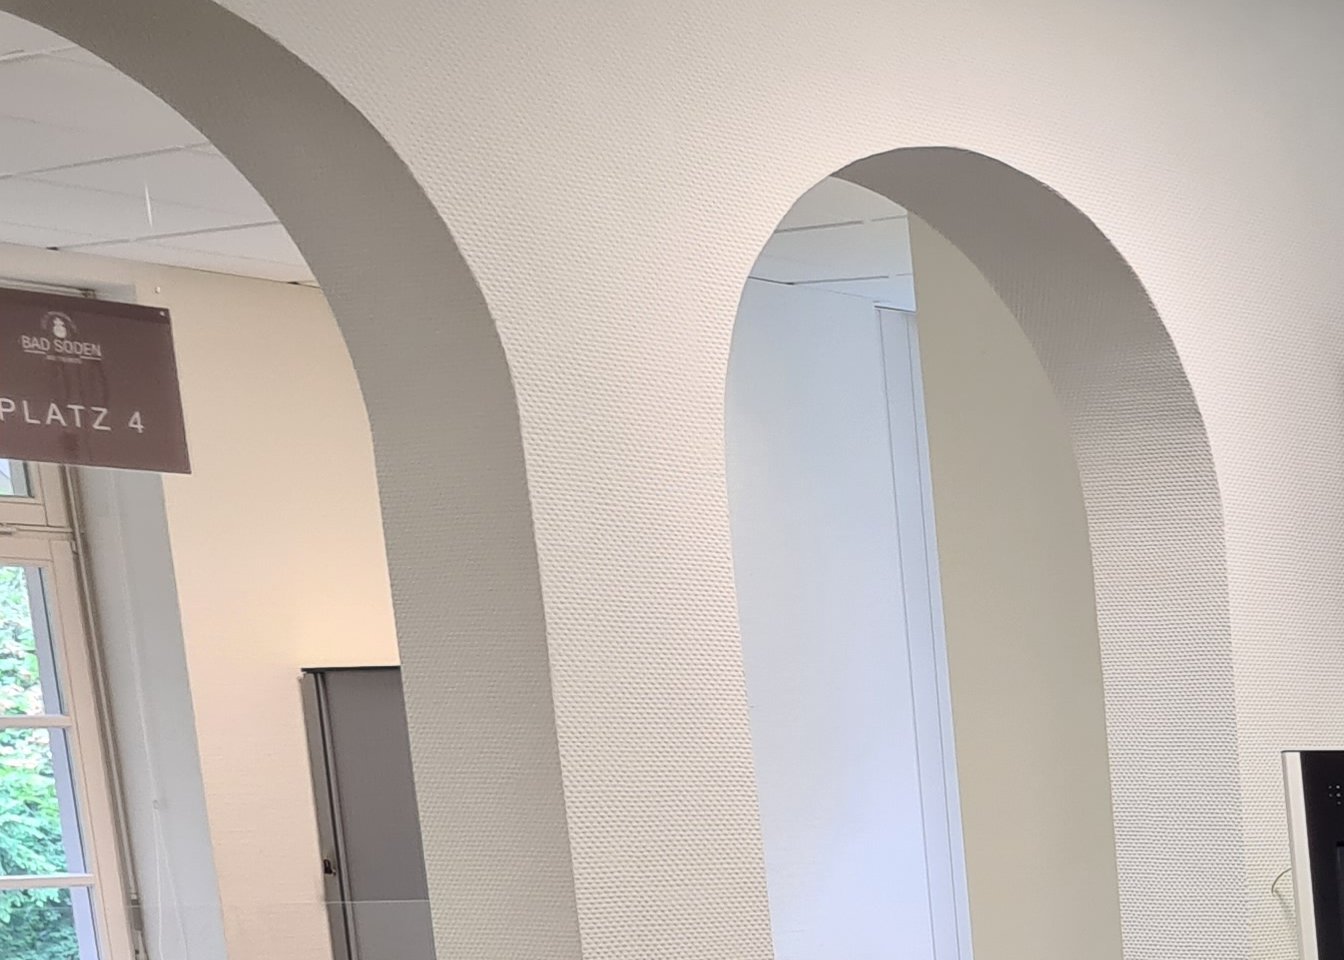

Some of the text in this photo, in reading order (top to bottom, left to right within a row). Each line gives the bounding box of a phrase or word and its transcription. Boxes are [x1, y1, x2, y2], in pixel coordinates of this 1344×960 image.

[21, 334, 102, 357] BAD SODEN
[0, 398, 145, 434] PLATZ 4
